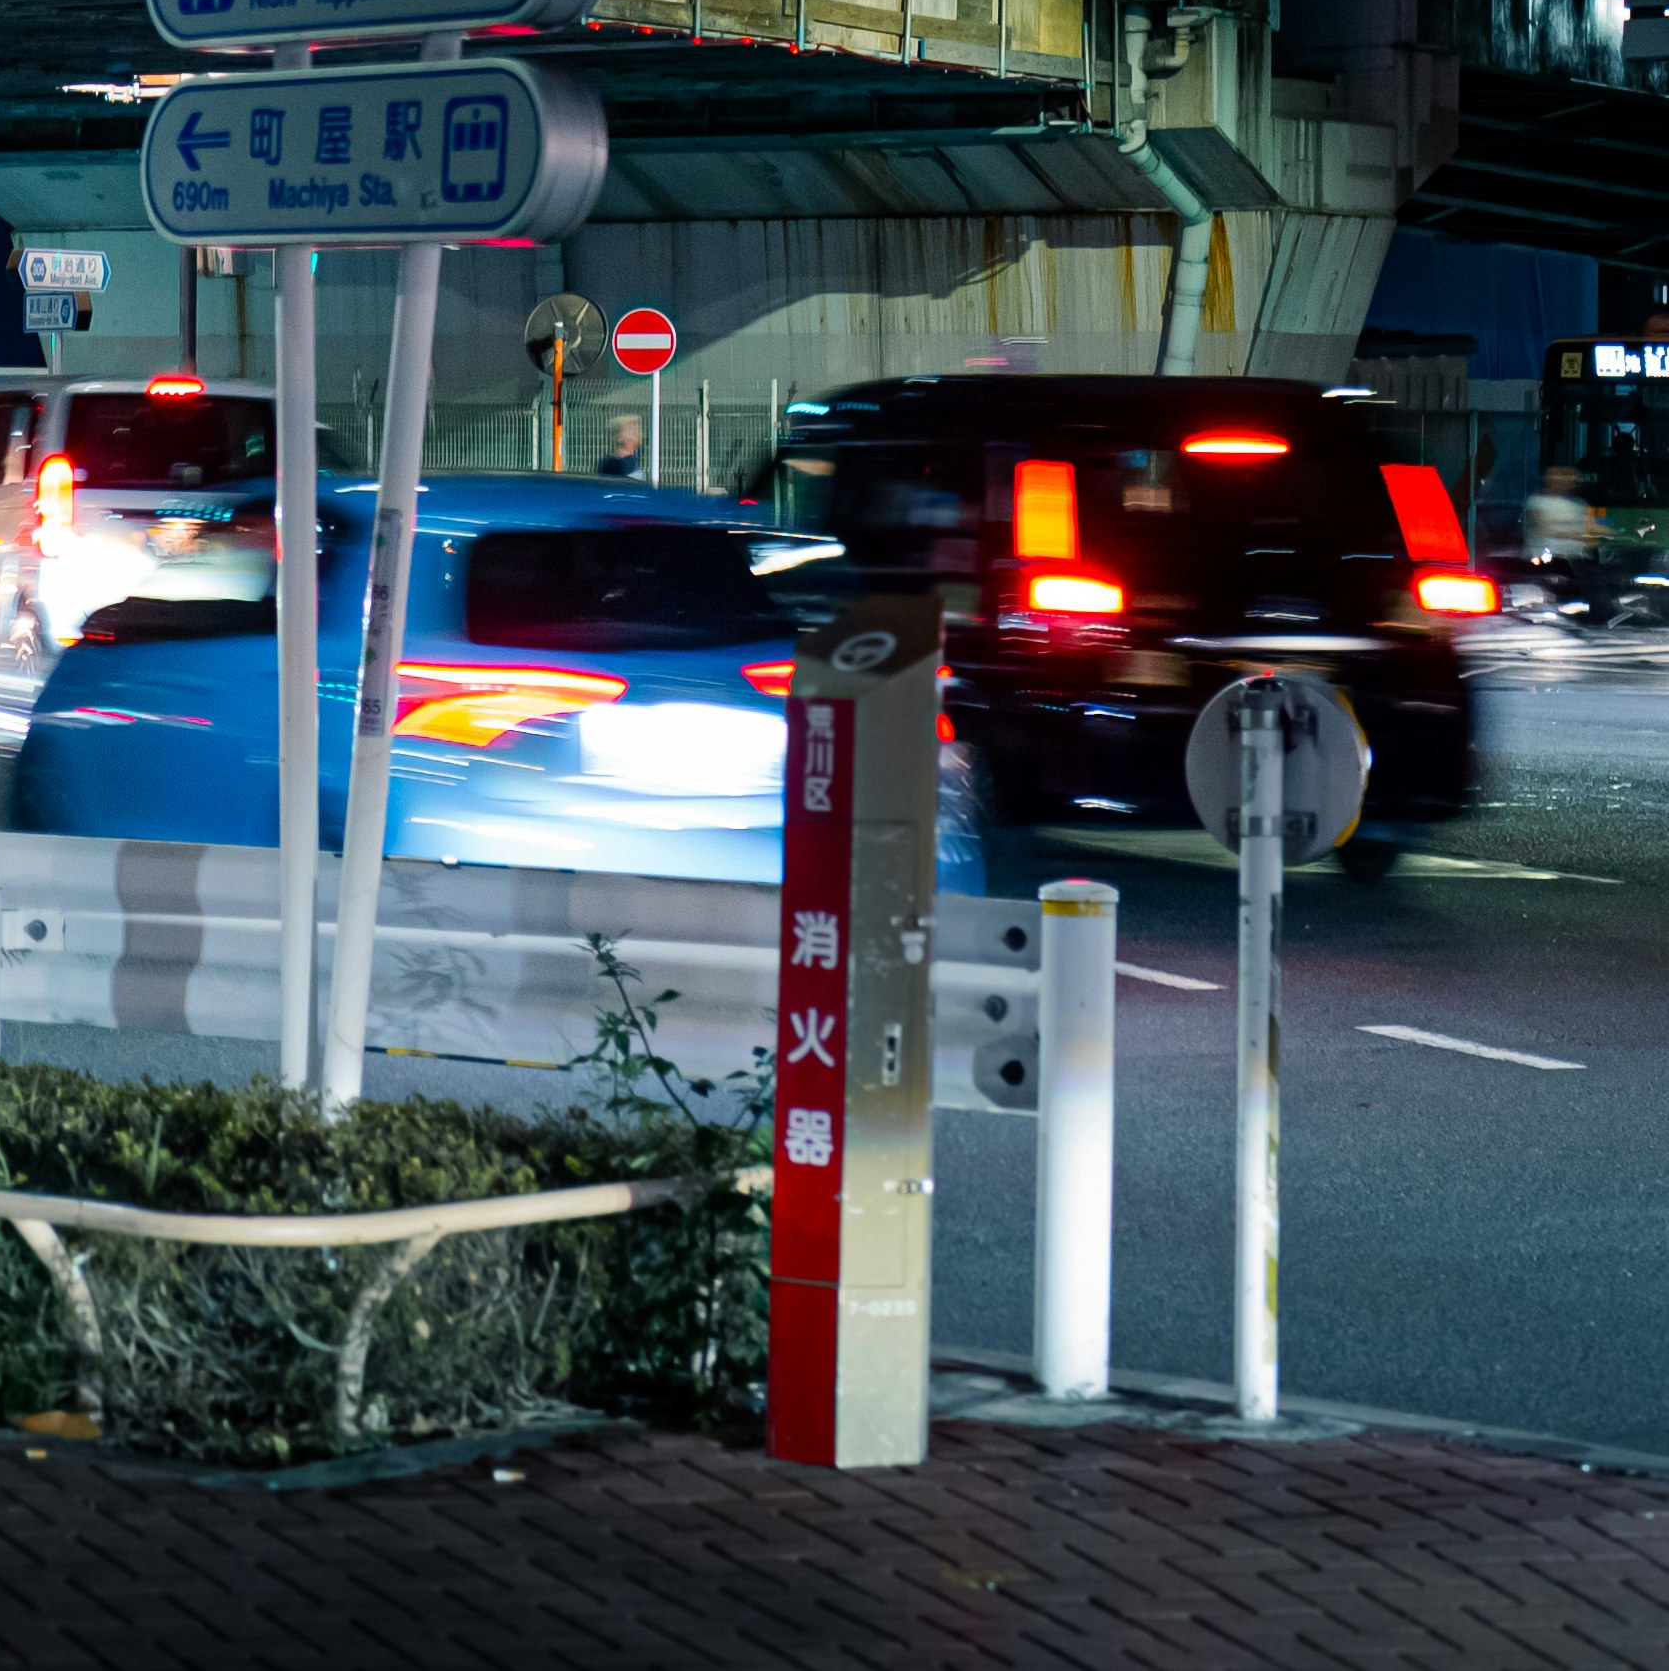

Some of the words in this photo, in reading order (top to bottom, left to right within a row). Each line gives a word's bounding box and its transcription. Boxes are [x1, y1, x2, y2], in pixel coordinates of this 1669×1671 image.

[250, 100, 423, 166] 町屋駅
[172, 181, 229, 212] 690m
[268, 178, 350, 215] Machiya
[359, 173, 398, 207] Sta.
[804, 705, 834, 812] 荒川区
[784, 910, 839, 1167] 消火器
